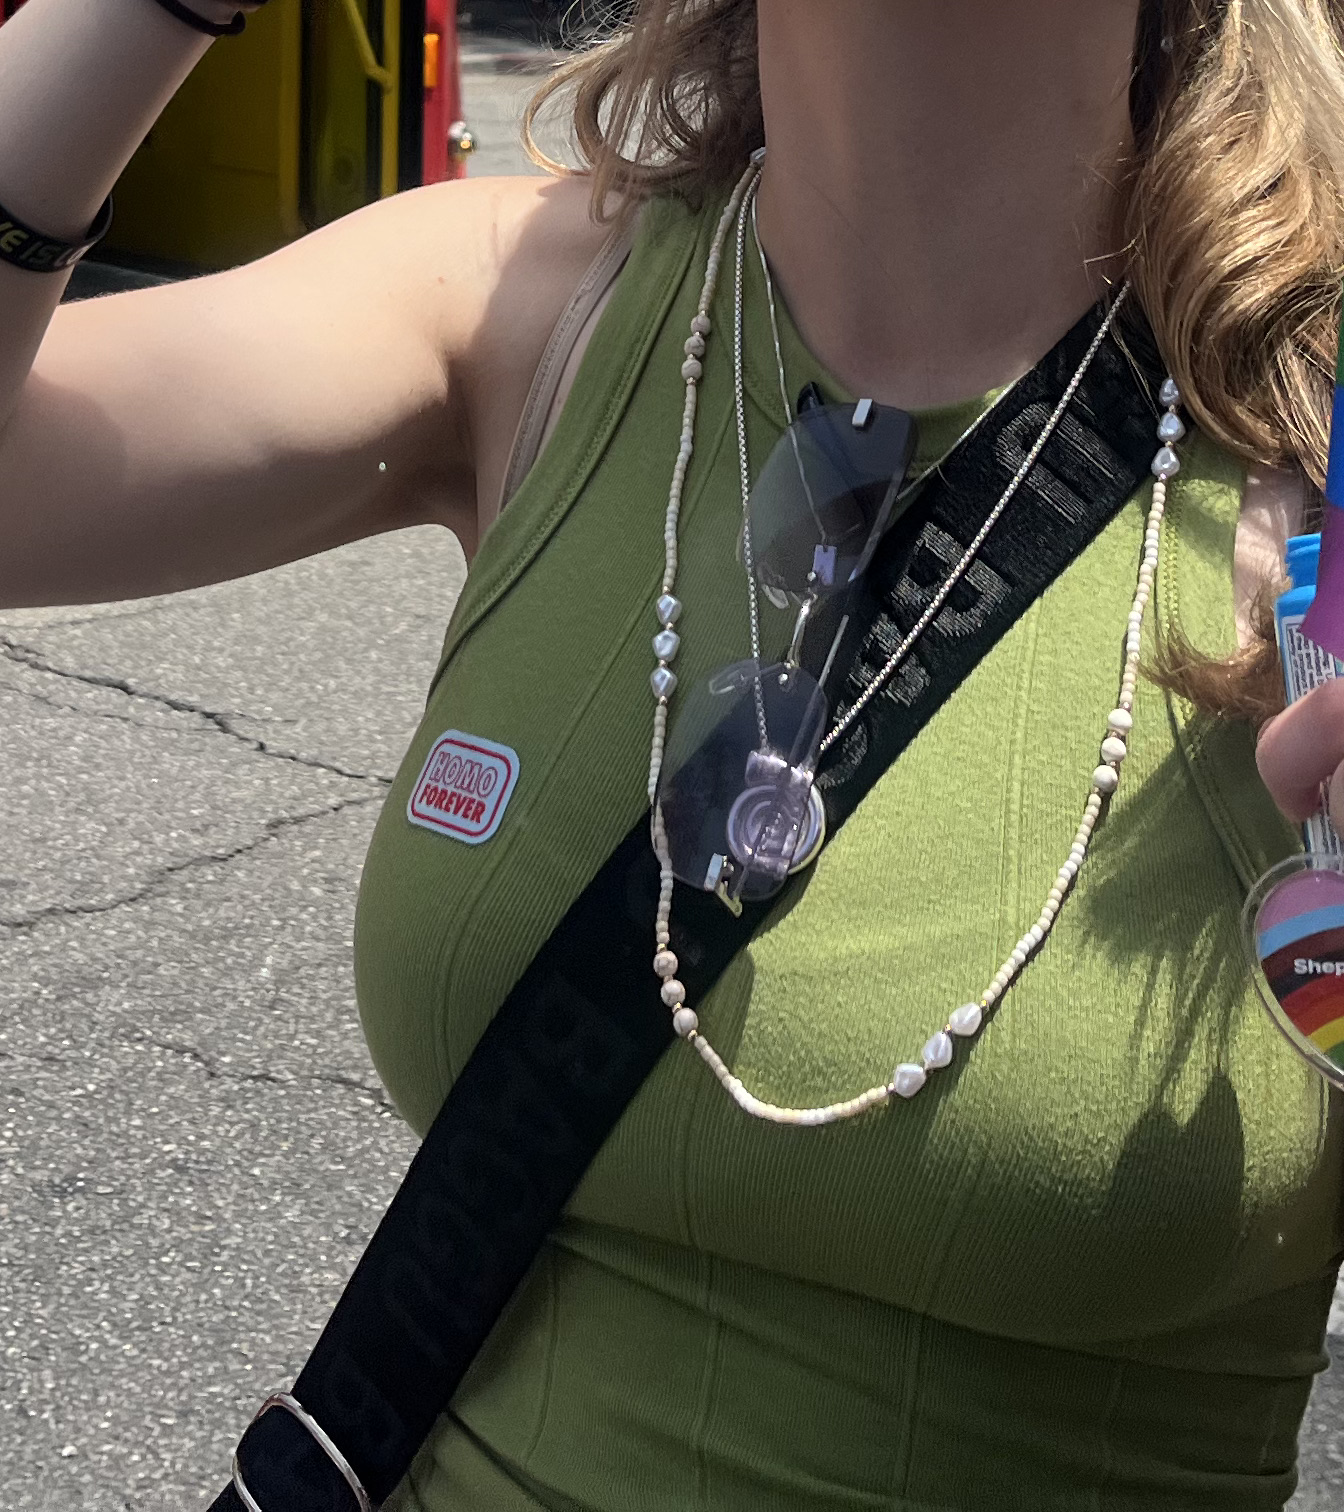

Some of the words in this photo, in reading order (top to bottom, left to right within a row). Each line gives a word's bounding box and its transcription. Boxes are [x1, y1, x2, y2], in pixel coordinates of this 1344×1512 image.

[19, 241, 60, 265] IS
[429, 750, 498, 799] HOMO
[419, 783, 486, 824] FOREVER
